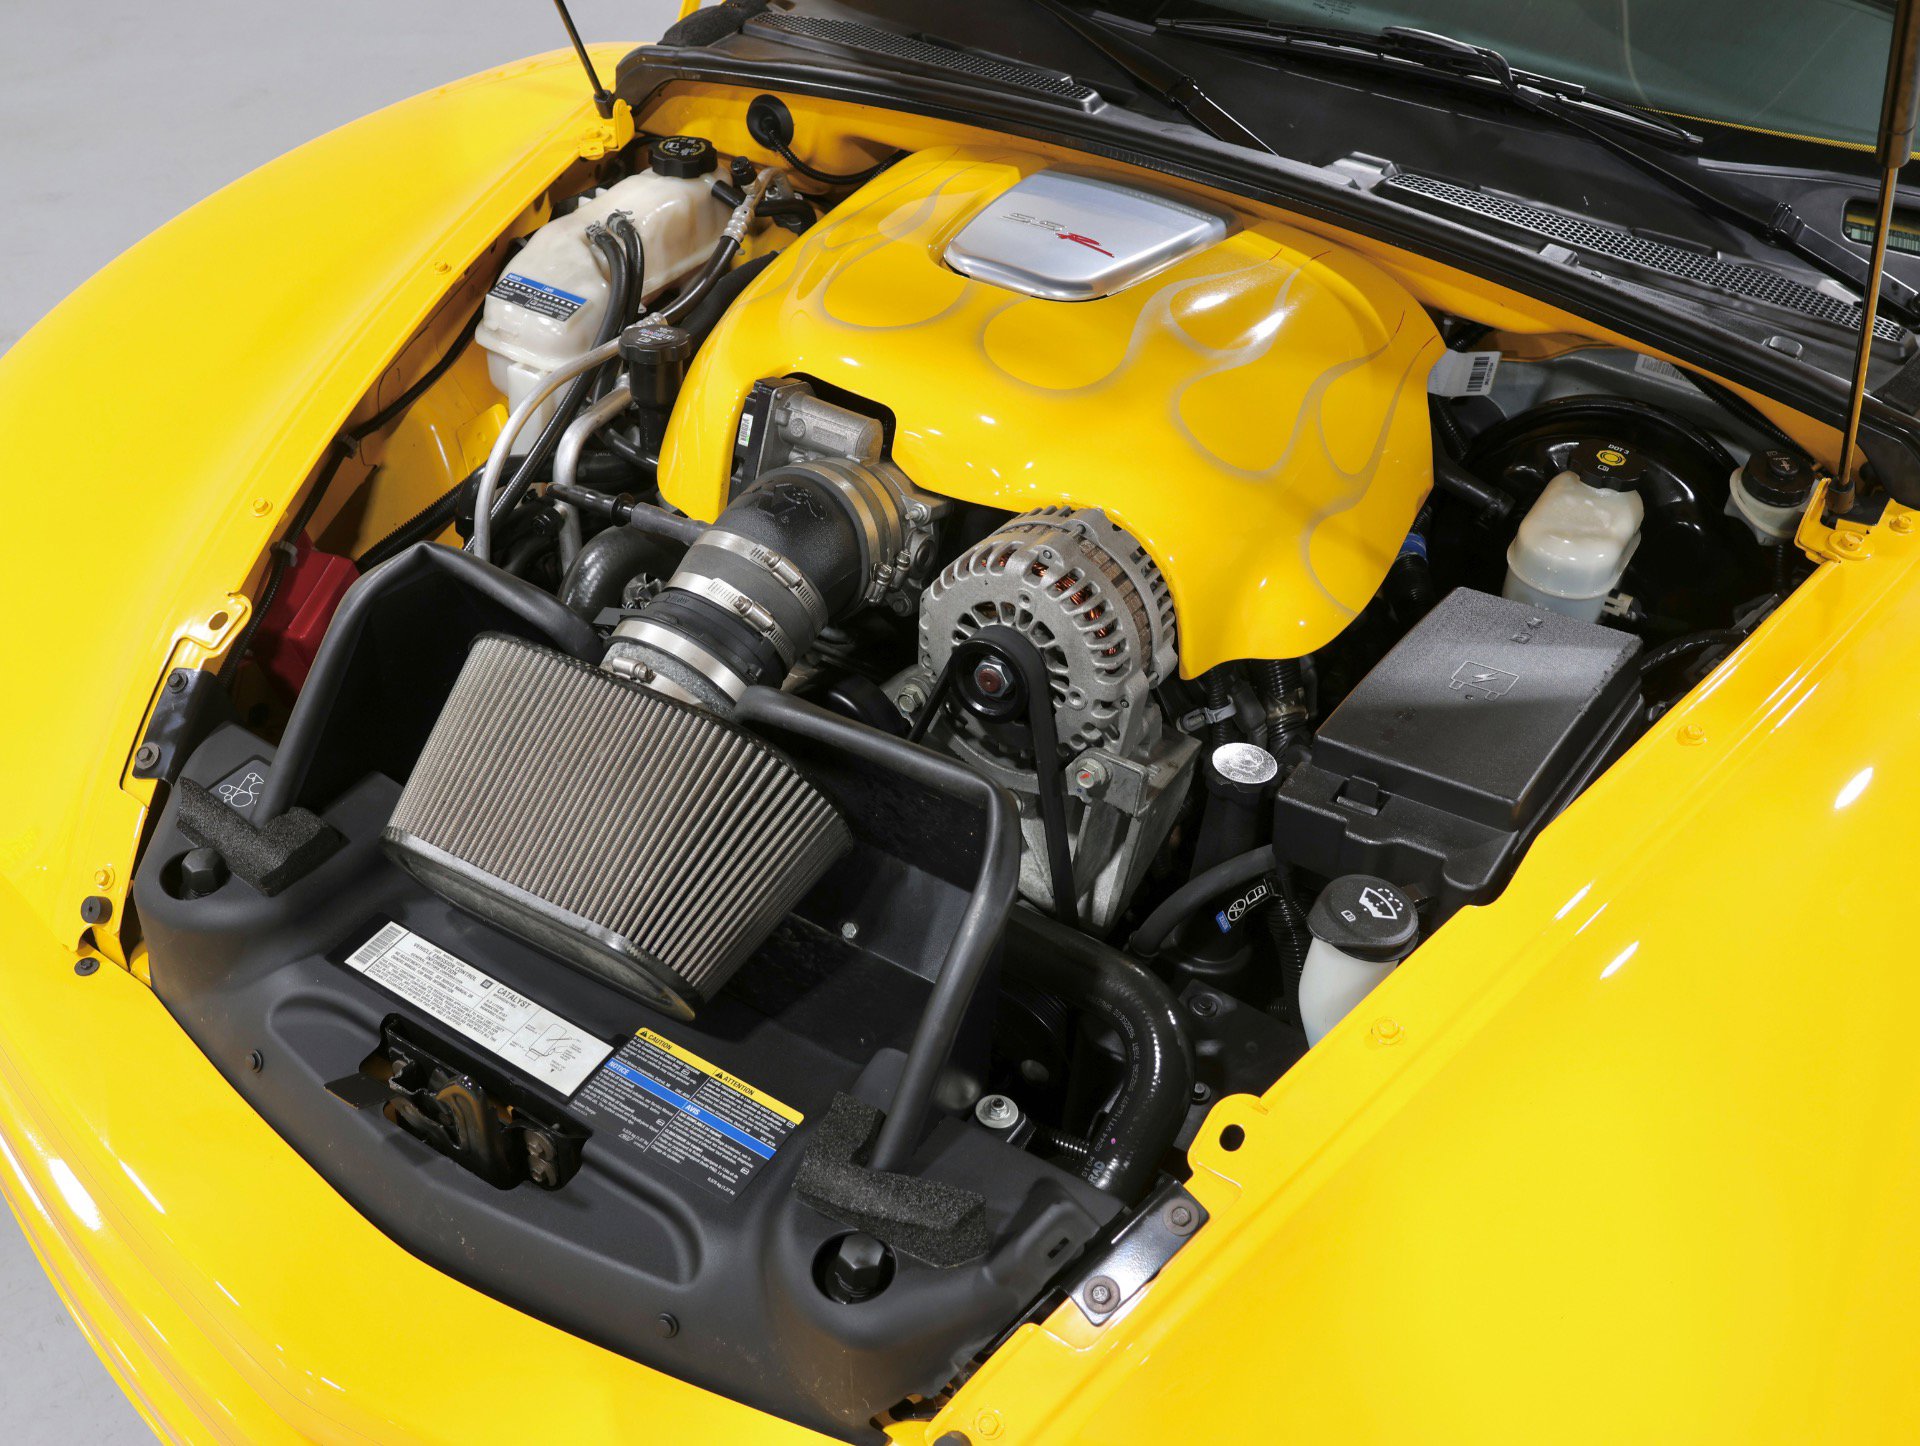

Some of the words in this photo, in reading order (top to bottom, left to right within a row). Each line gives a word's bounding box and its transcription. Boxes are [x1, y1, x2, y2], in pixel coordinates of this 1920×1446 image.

[1608, 444, 1624, 452] DOT
[413, 942, 433, 957] VEHICLE
[432, 951, 455, 969] EMISSION
[455, 963, 477, 981] CONTROL
[426, 955, 457, 976] INFORMATION
[497, 987, 532, 1009] CATALYST
[648, 1034, 673, 1051] CAUTION
[609, 1060, 630, 1076] NOTICE
[723, 1076, 755, 1096] ATTENTION
[685, 1103, 700, 1116] AVIS
[1088, 1160, 1106, 1184] RAD
